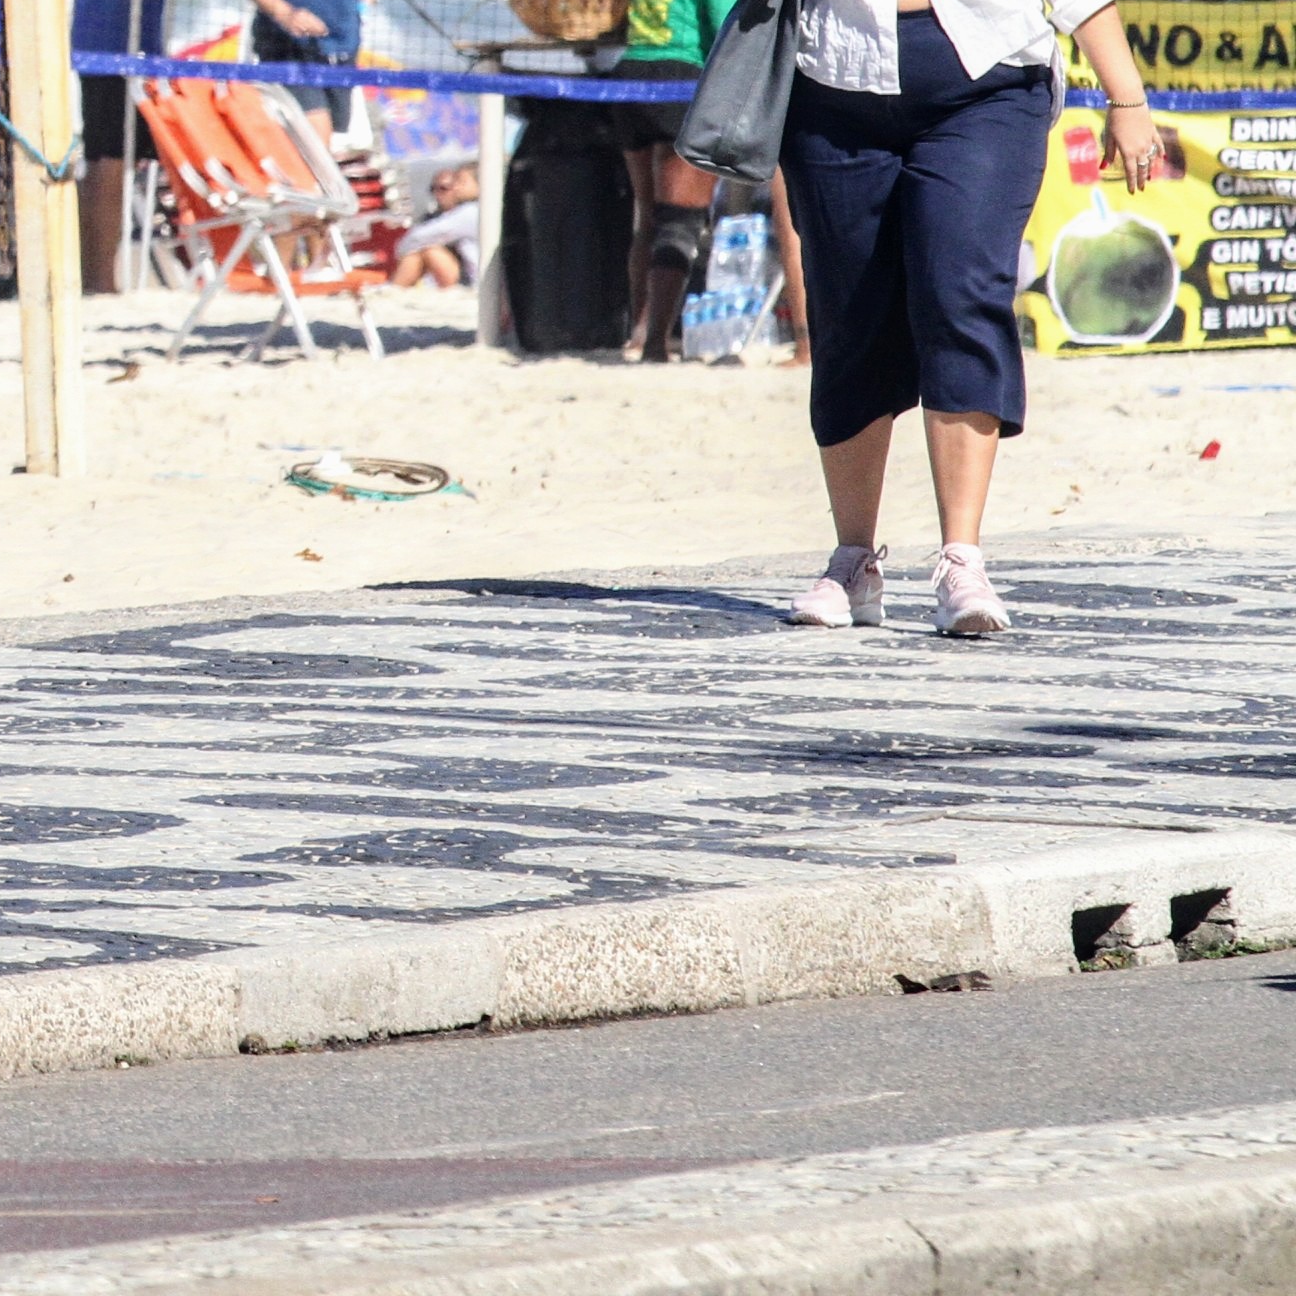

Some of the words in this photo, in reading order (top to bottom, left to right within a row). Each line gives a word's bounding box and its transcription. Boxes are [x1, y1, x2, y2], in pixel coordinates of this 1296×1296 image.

[1215, 30, 1244, 62] &
[1253, 22, 1296, 70] A
[1211, 239, 1260, 263] GIN
[1202, 306, 1222, 330] E
